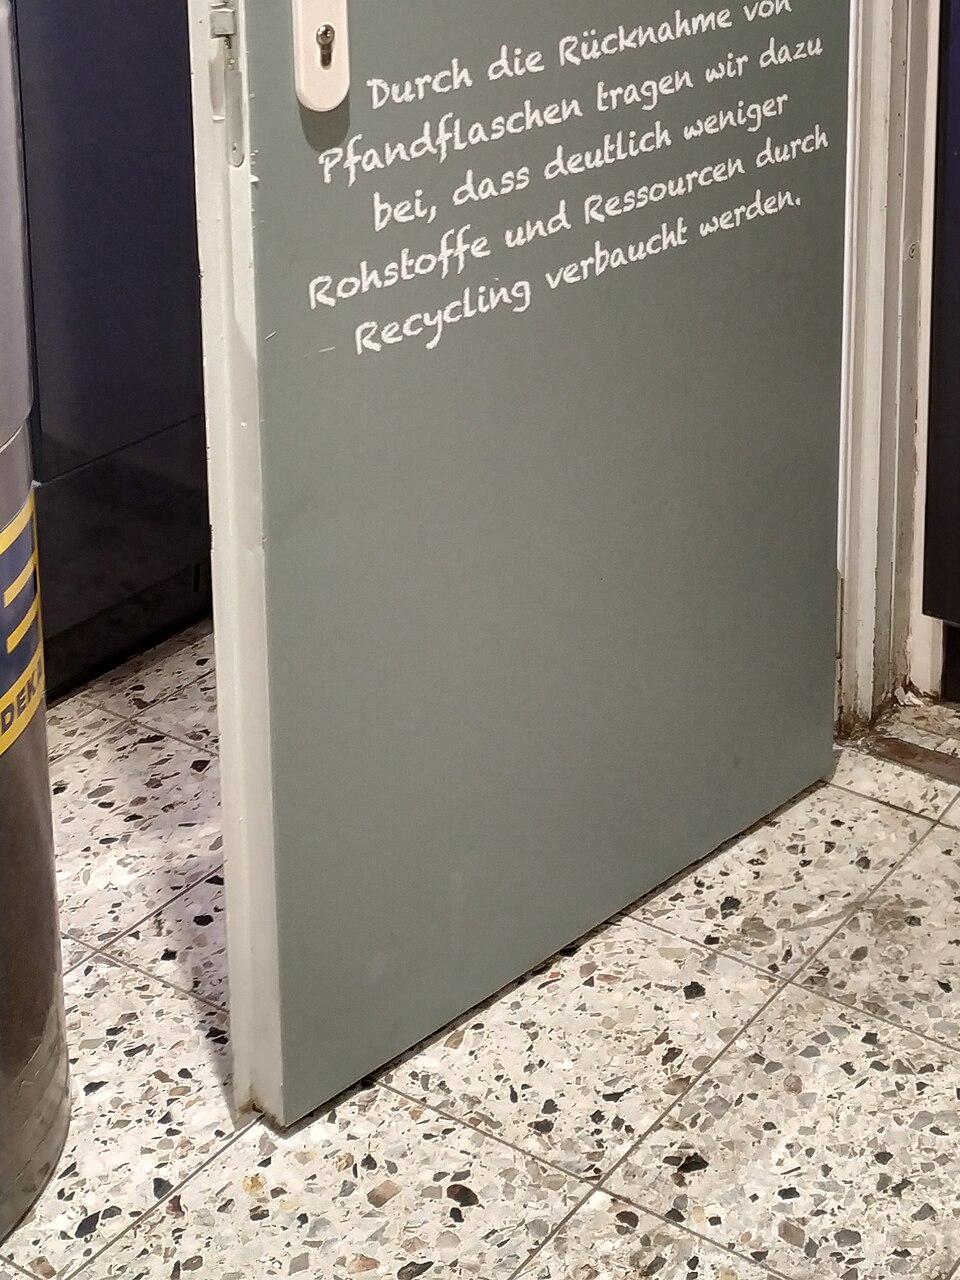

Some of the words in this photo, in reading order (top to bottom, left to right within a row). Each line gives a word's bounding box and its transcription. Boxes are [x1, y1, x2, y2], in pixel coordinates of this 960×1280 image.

[318, 97, 584, 188] Pfandflaschen
[597, 69, 693, 112] tragen
[706, 52, 748, 83] wir
[759, 36, 823, 69] dazu
[366, 58, 473, 110] Durch
[487, 44, 544, 81] die
[558, 8, 733, 67] Rücknahme
[308, 224, 491, 310] Rohstoffe
[505, 200, 571, 249] und
[584, 158, 745, 225] Ressourcen
[756, 125, 828, 167] durch
[373, 191, 437, 232] bei,
[453, 166, 530, 206] dass
[544, 122, 671, 180] deutlich
[683, 93, 788, 140] weniger
[355, 277, 531, 355] Recycling
[545, 217, 687, 289] verbaucht
[700, 188, 801, 236] werden.
